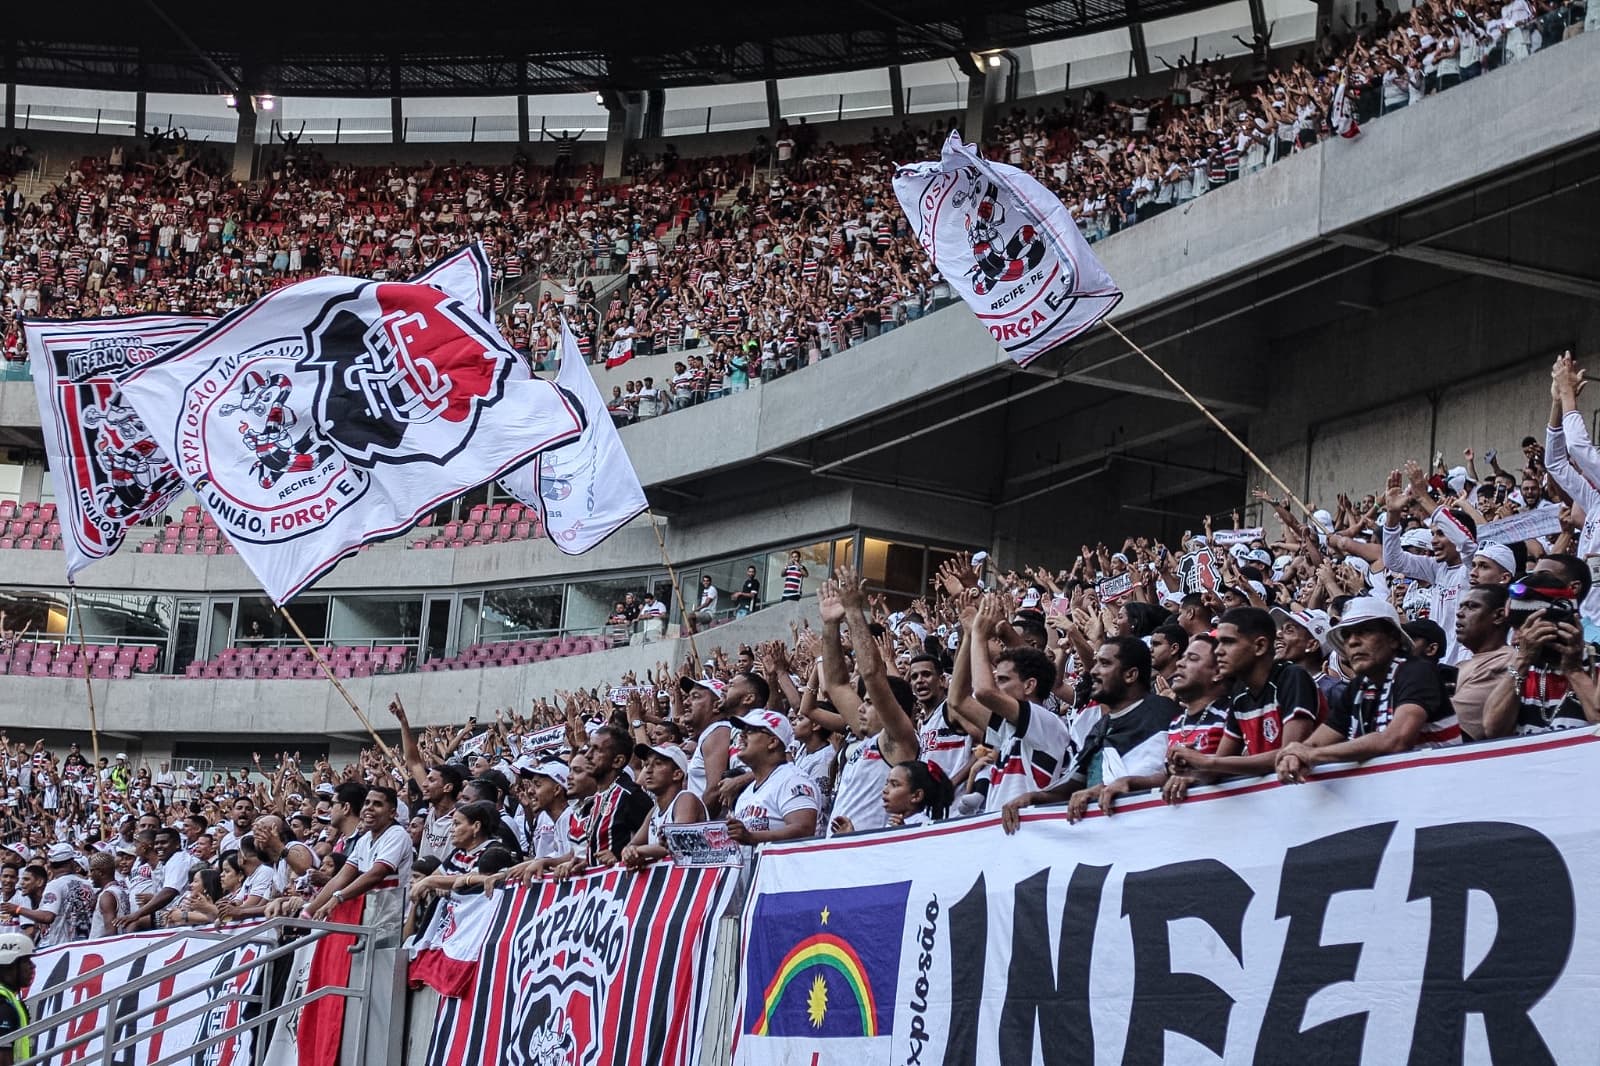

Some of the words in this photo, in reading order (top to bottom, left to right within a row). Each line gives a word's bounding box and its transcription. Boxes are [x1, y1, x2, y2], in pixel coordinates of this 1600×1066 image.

[991, 283, 1025, 310] RECIFE
[1030, 270, 1044, 285] PE
[989, 309, 1047, 342] ORÇA
[183, 379, 217, 477] EXPLOSÃO
[278, 476, 316, 500] RECIFE
[322, 462, 336, 476] PE
[80, 488, 113, 537] UNIÃO,
[208, 492, 266, 537] UNIÃO,
[270, 497, 338, 533] FORÇA
[336, 479, 354, 497] E
[517, 895, 625, 984] EXPLOSÃO
[898, 892, 940, 1066] xplosão
